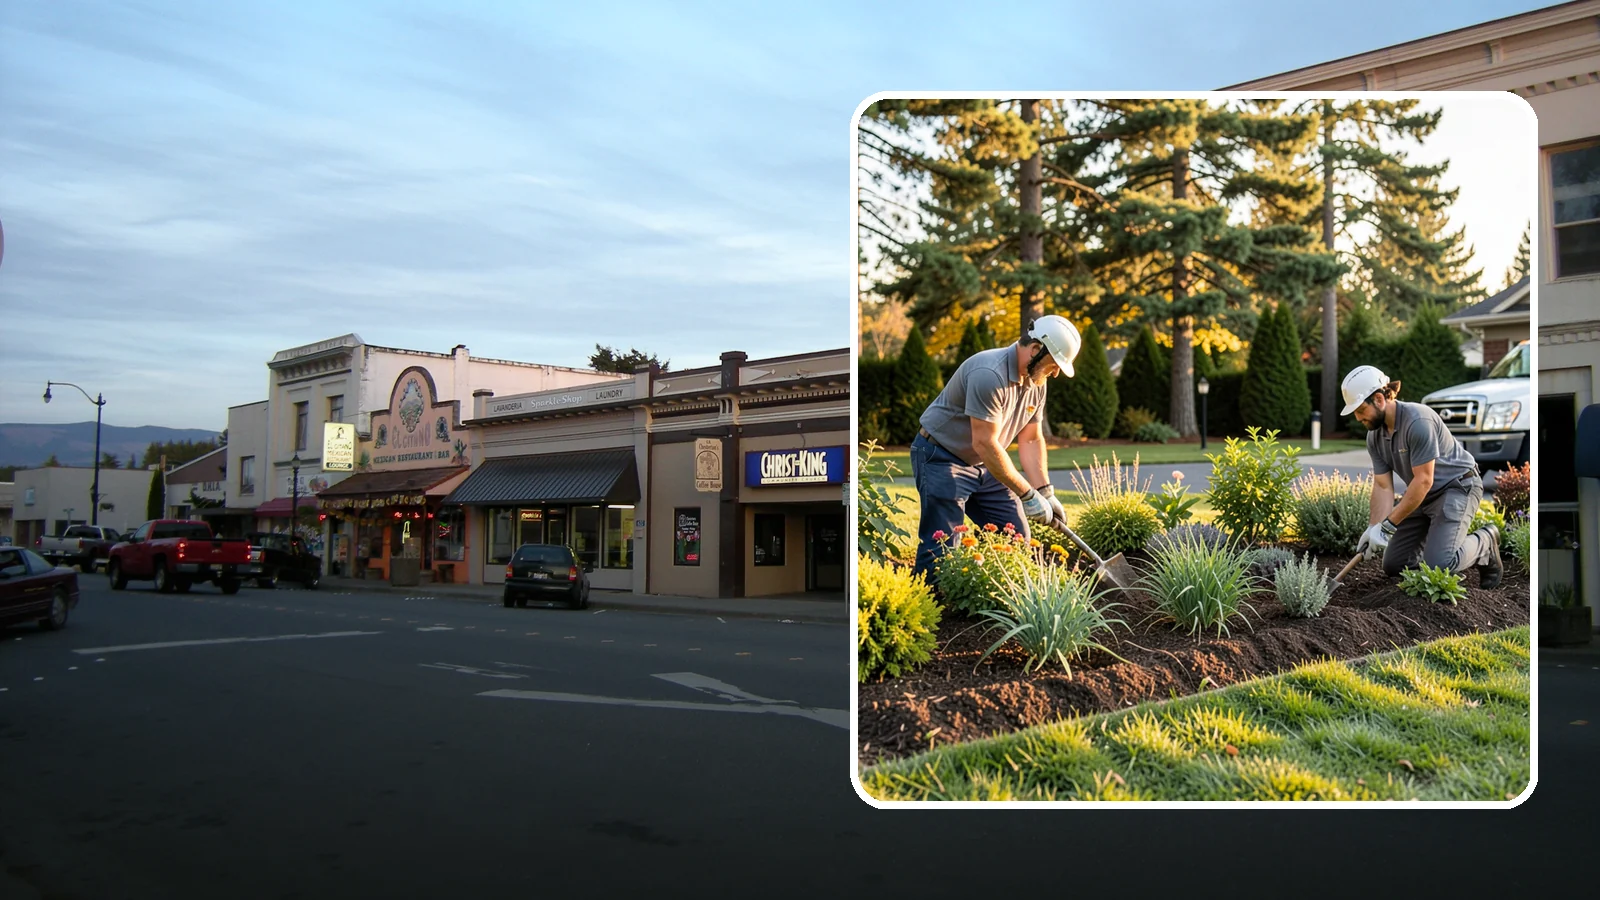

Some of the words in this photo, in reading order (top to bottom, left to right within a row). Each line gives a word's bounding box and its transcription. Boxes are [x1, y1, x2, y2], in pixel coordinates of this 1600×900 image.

[561, 394, 582, 405] Shop
[595, 389, 624, 400] LAUNDRY
[493, 402, 523, 413] LAVANDERIA
[373, 455, 396, 464] MEXICAN
[397, 452, 433, 462] RESTAURANT
[438, 450, 450, 459] BAR
[761, 452, 797, 478] CHRIST
[799, 450, 827, 476] KING
[696, 481, 709, 489] Coffee
[710, 481, 722, 489] House
